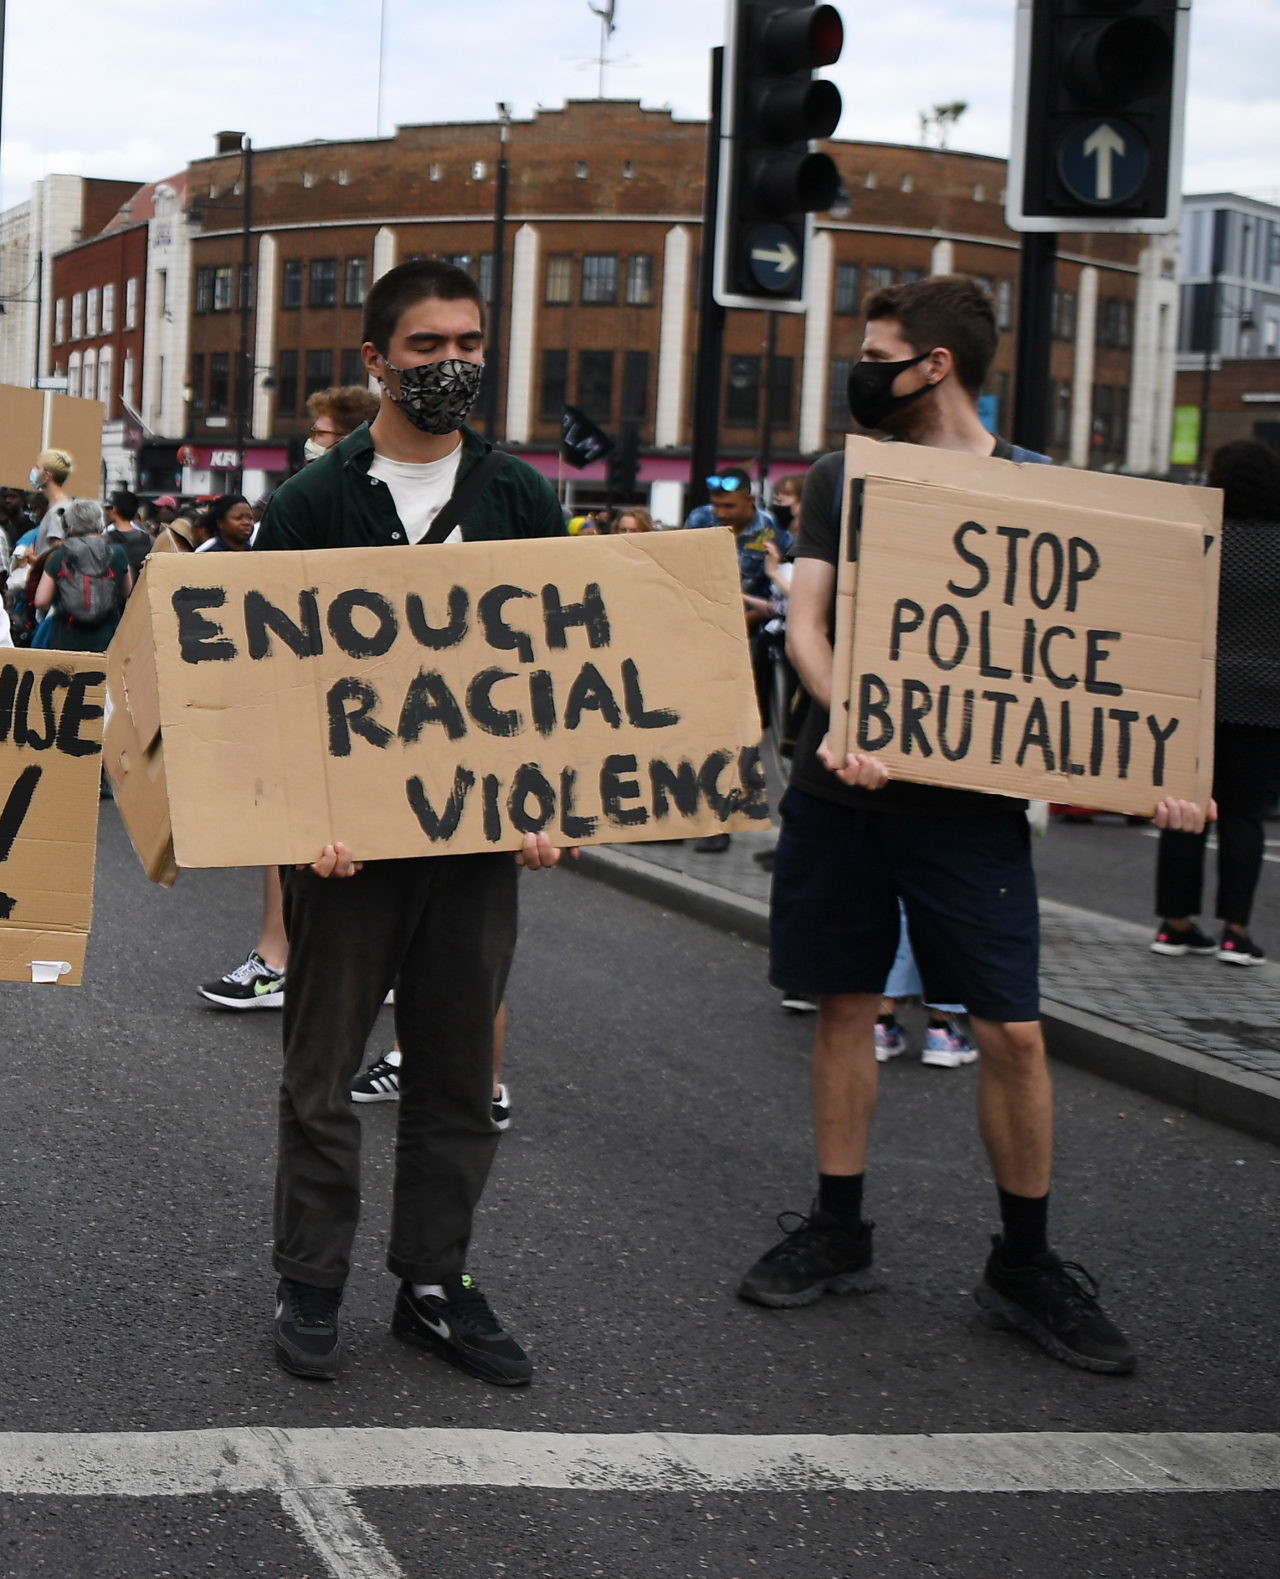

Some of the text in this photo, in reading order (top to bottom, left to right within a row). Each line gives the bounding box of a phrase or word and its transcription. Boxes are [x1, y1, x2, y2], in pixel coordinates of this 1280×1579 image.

[947, 520, 1100, 612] STOP
[171, 582, 612, 664] ENOUGH
[889, 598, 1123, 696] POLICE
[326, 658, 680, 757] RACIAL
[856, 673, 1180, 787] BRUTALITY
[406, 745, 770, 843] VIOLENCE
